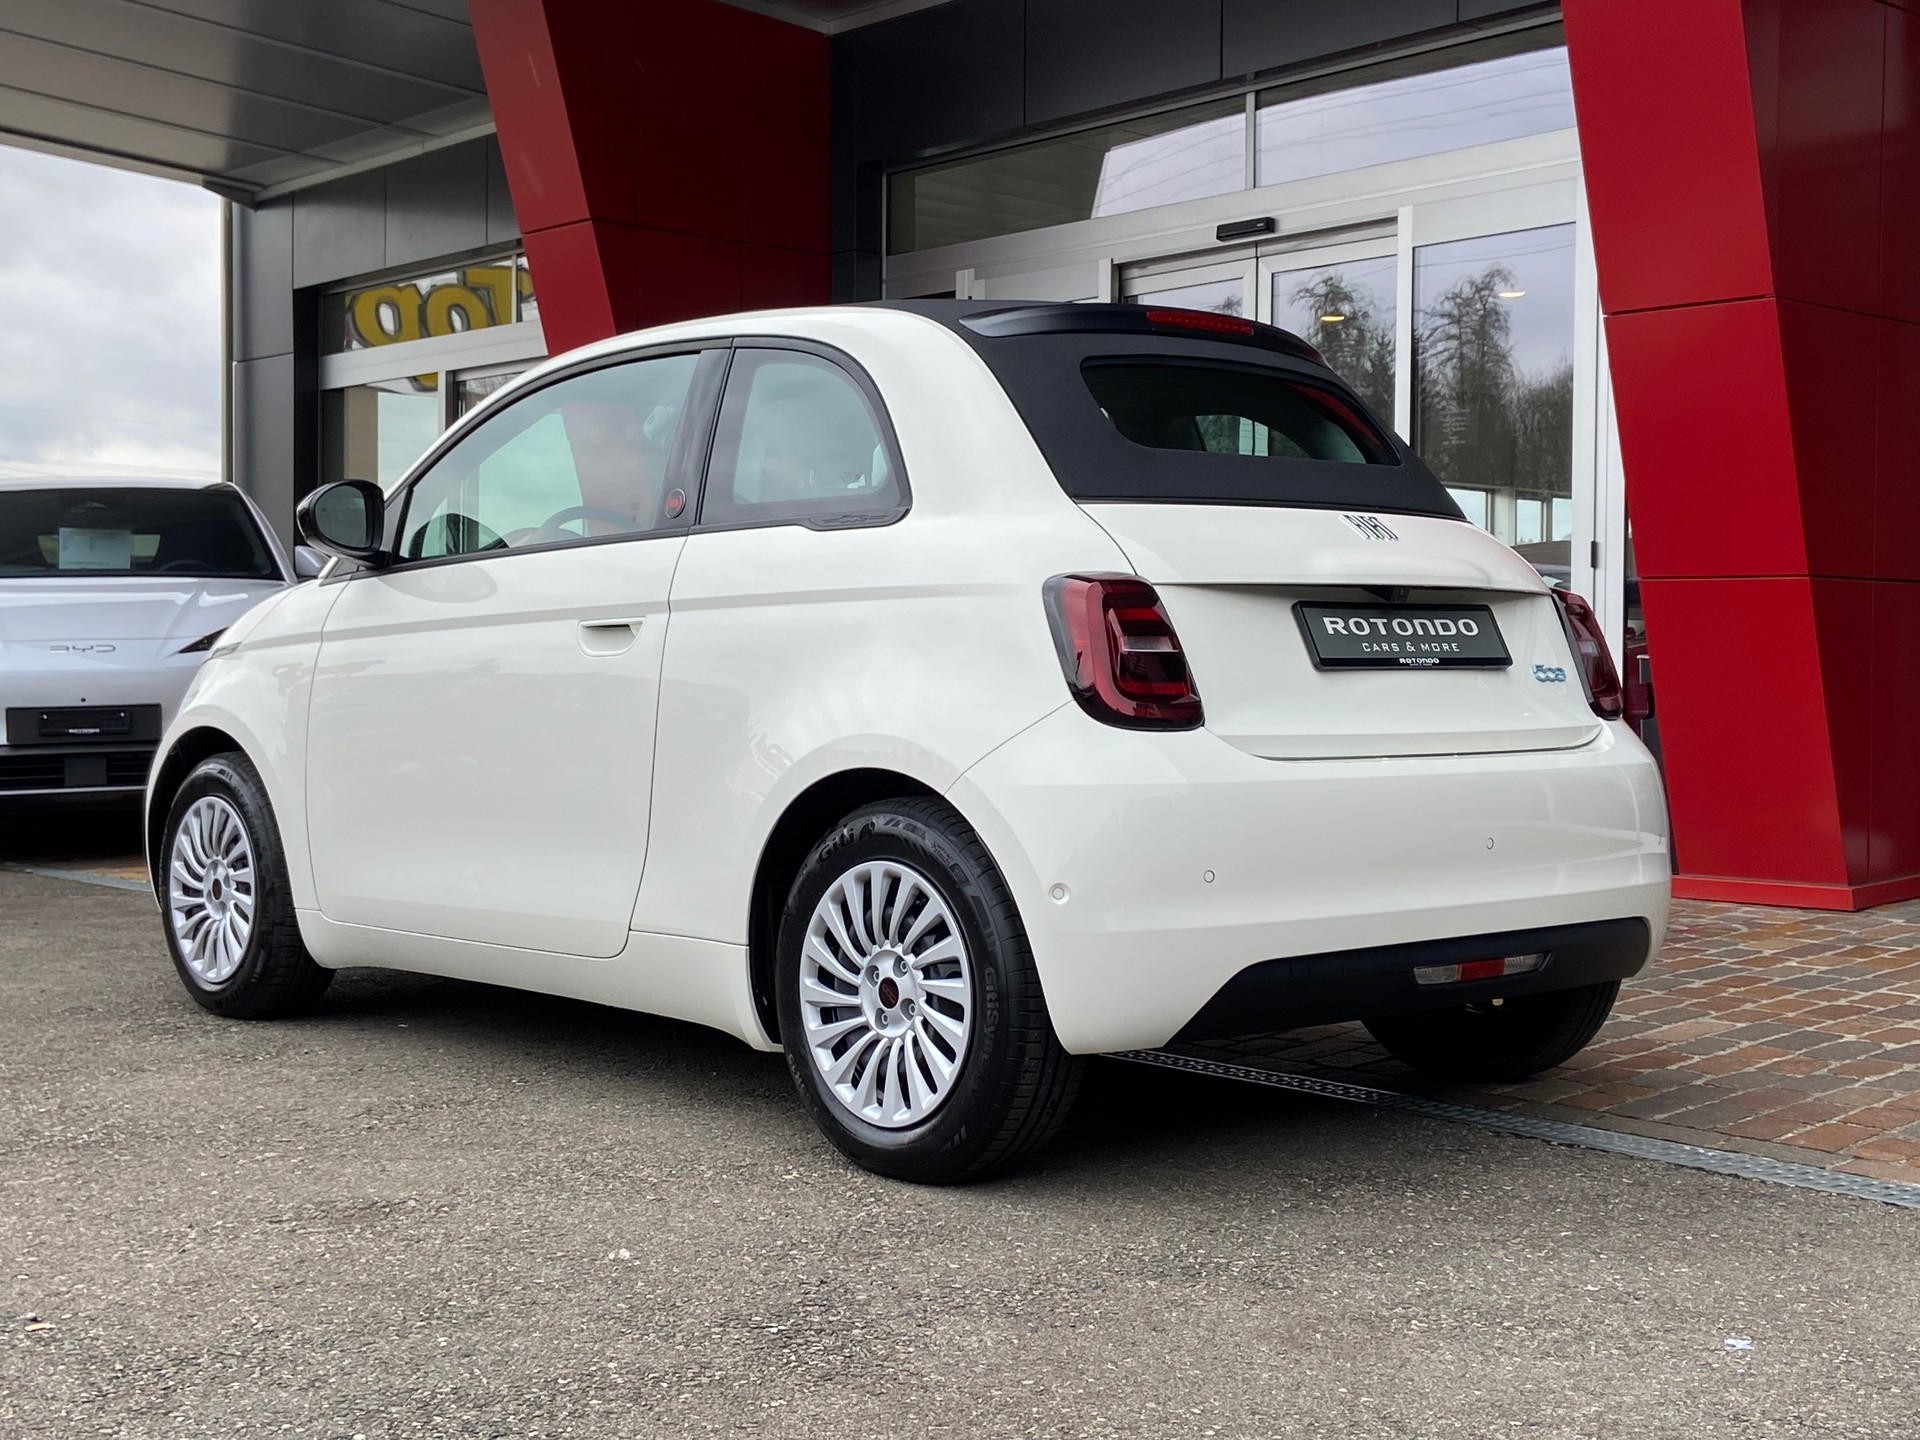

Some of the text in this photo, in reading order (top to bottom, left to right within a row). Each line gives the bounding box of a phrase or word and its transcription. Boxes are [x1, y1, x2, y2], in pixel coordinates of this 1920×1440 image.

[1322, 616, 1480, 636] ROTONDO
[1361, 641, 1461, 652] CARS & MORE
